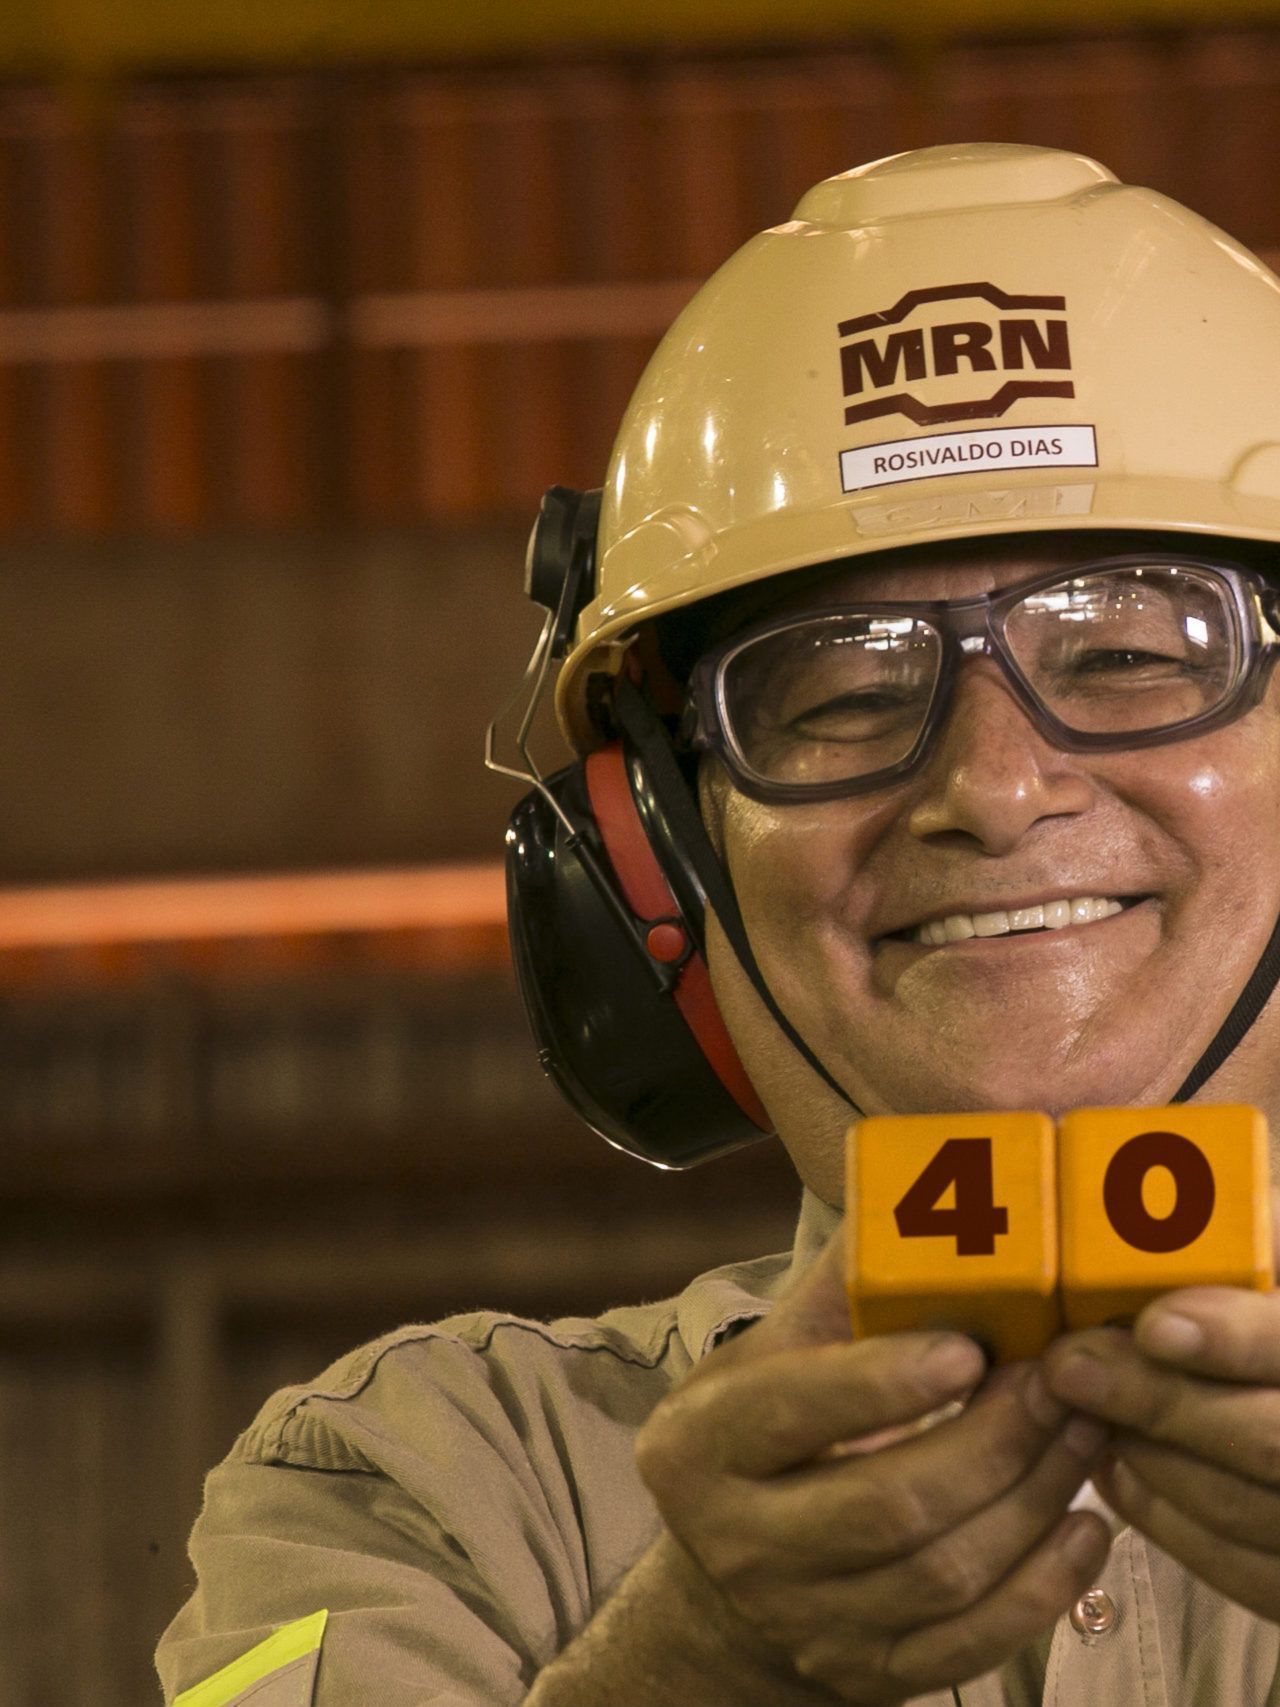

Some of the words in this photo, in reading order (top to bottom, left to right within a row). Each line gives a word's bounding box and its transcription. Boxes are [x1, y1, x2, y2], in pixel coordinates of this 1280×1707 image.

[839, 319, 1072, 398] MRN
[873, 440, 1004, 475] ROSIVALDO
[1010, 438, 1064, 458] DIAS
